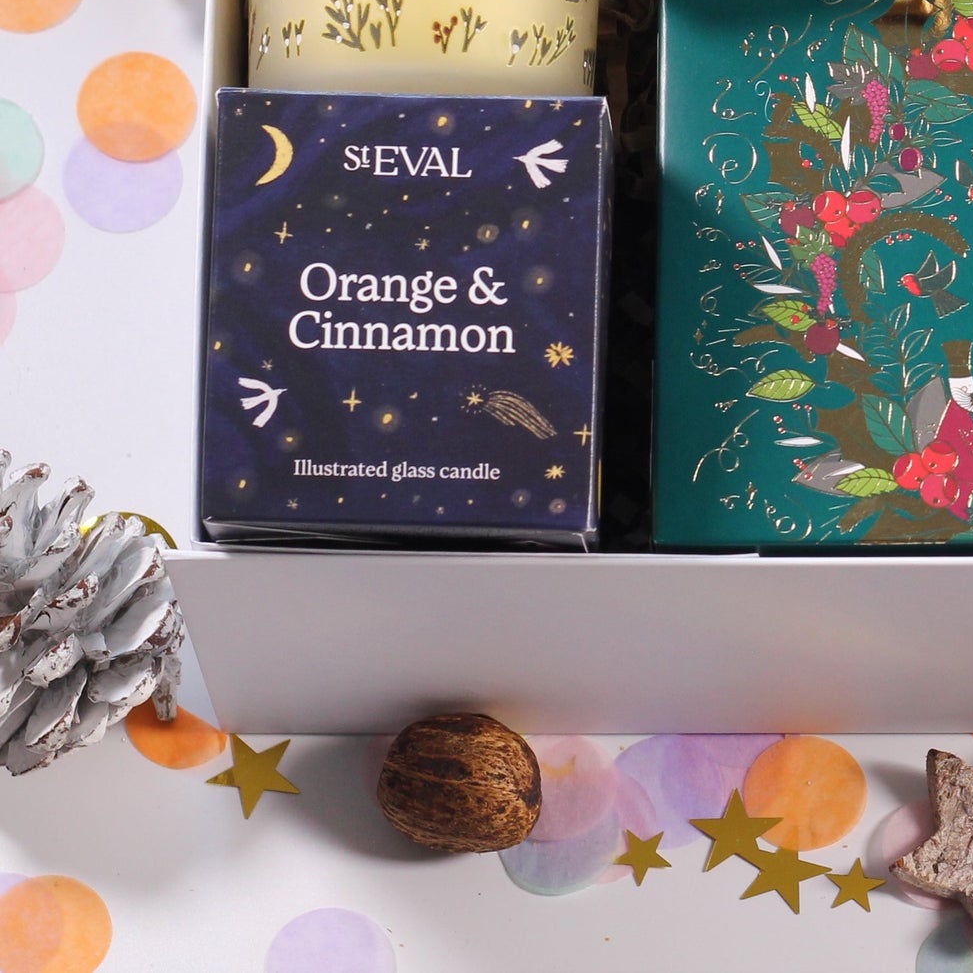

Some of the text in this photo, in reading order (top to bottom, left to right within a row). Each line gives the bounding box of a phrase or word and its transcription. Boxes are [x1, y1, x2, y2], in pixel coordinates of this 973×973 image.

[299, 262, 508, 313] Orange &
[288, 310, 516, 353] Cinnamon
[293, 459, 501, 482] Illustrated glass candle
